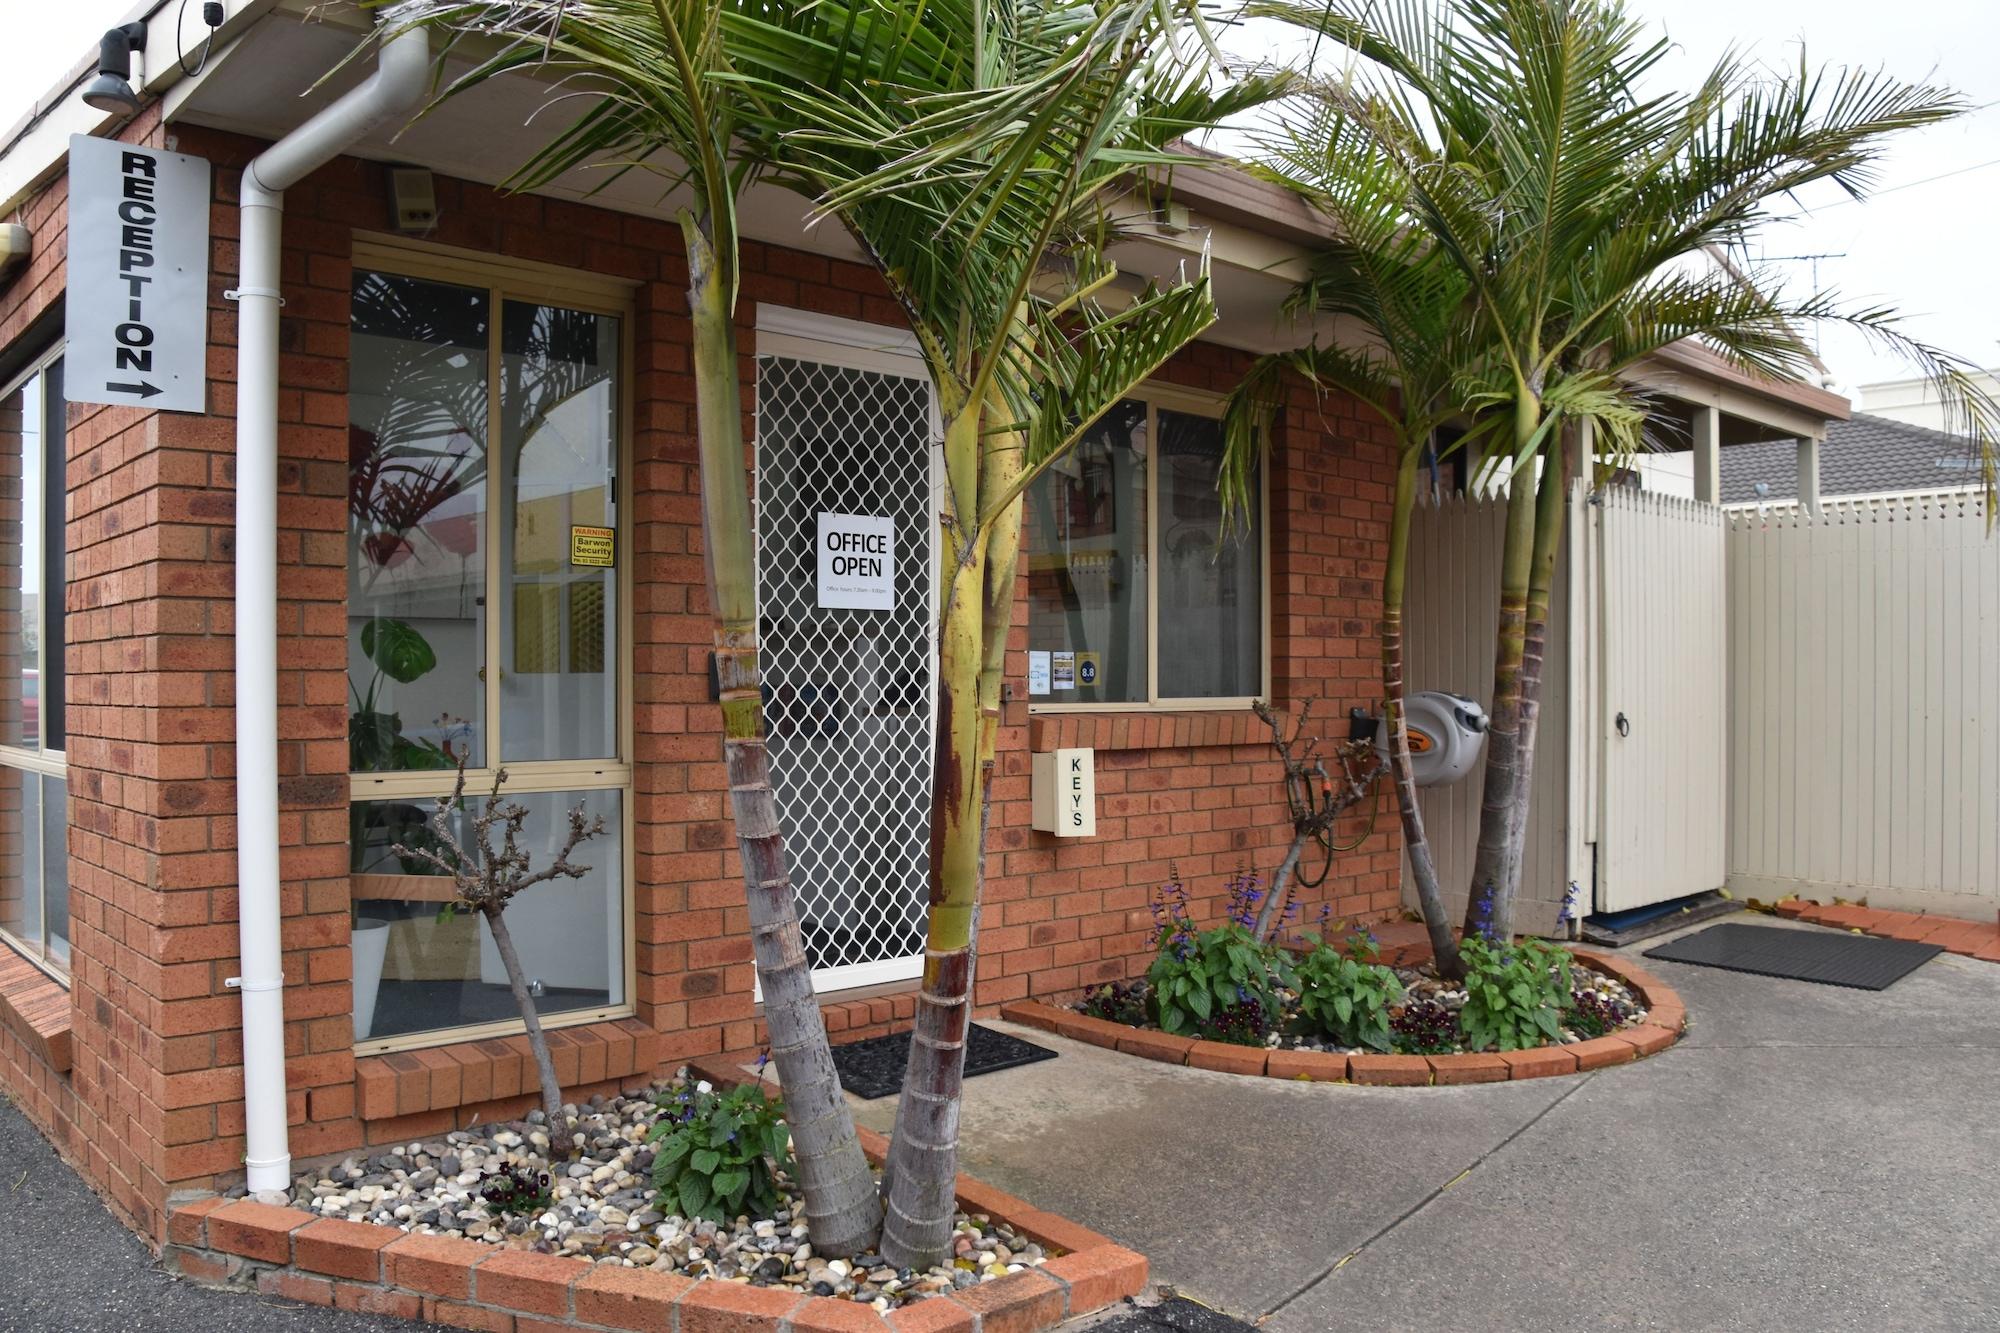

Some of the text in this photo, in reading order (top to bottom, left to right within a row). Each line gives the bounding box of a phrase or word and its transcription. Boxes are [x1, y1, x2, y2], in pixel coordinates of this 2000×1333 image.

[115, 151, 157, 372] RECEPTION
[575, 528, 612, 537] WARNING
[577, 538, 611, 547] Barwon
[827, 532, 887, 554] OFFICE
[576, 546, 612, 557] Security
[832, 556, 881, 577] OPEN
[1082, 668, 1095, 677] 8.8
[1072, 758, 1082, 826] KEYS
